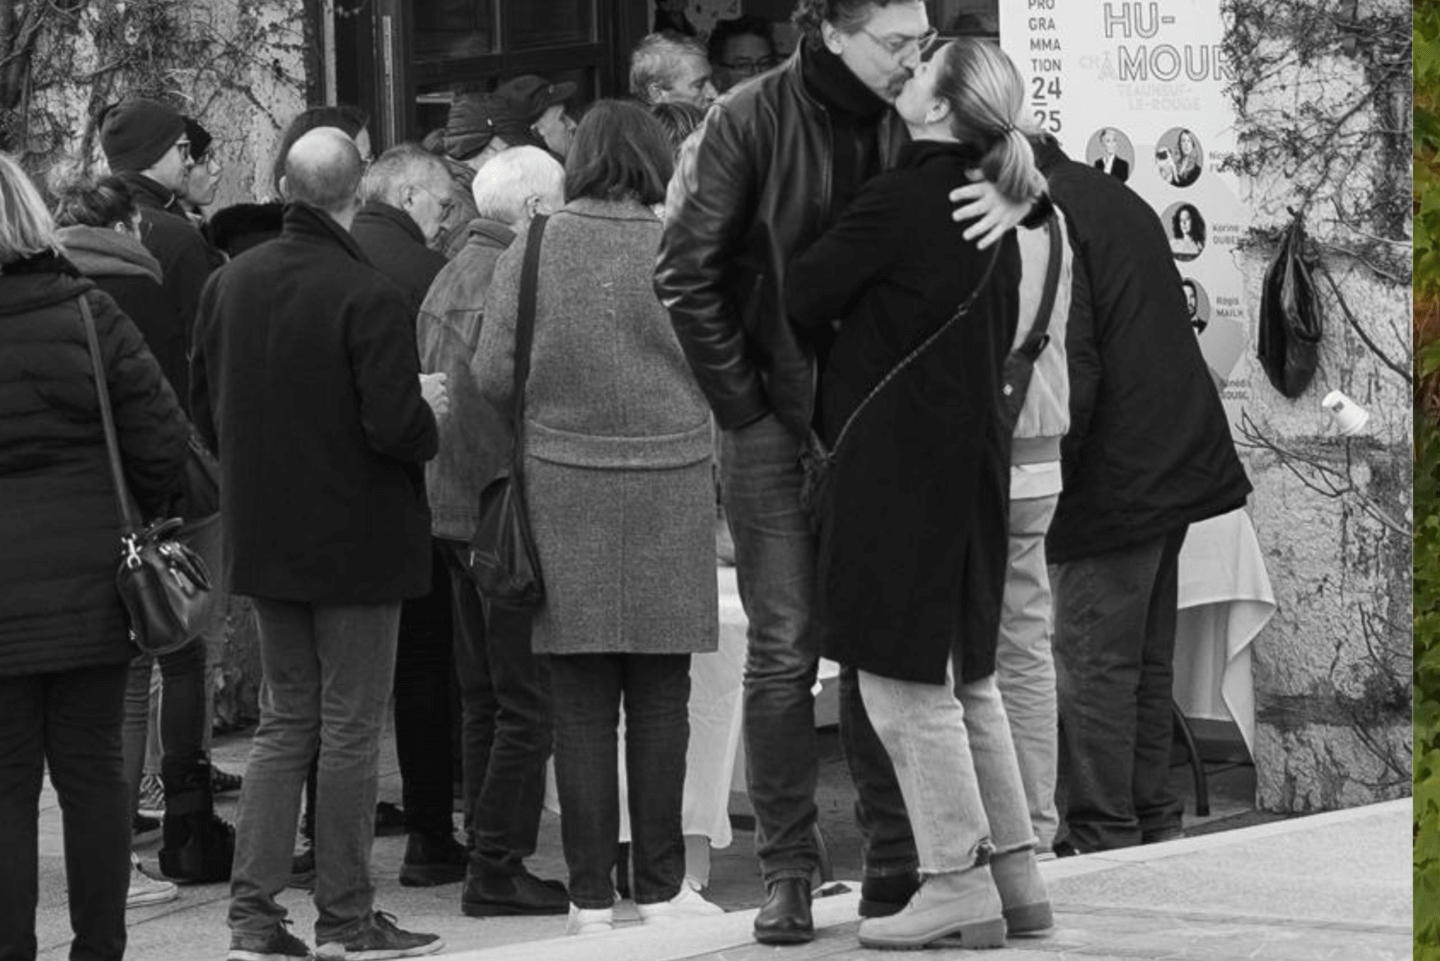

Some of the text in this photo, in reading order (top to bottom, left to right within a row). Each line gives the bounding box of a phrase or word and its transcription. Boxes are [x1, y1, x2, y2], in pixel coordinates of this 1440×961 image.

[1028, 17, 1057, 31] GRA
[1103, 1, 1176, 38] HU-
[1029, 38, 1062, 52] MMA
[1030, 58, 1062, 72] TION
[1117, 44, 1238, 82] MOUR
[1031, 77, 1063, 100] 24
[1033, 110, 1063, 134] 25
